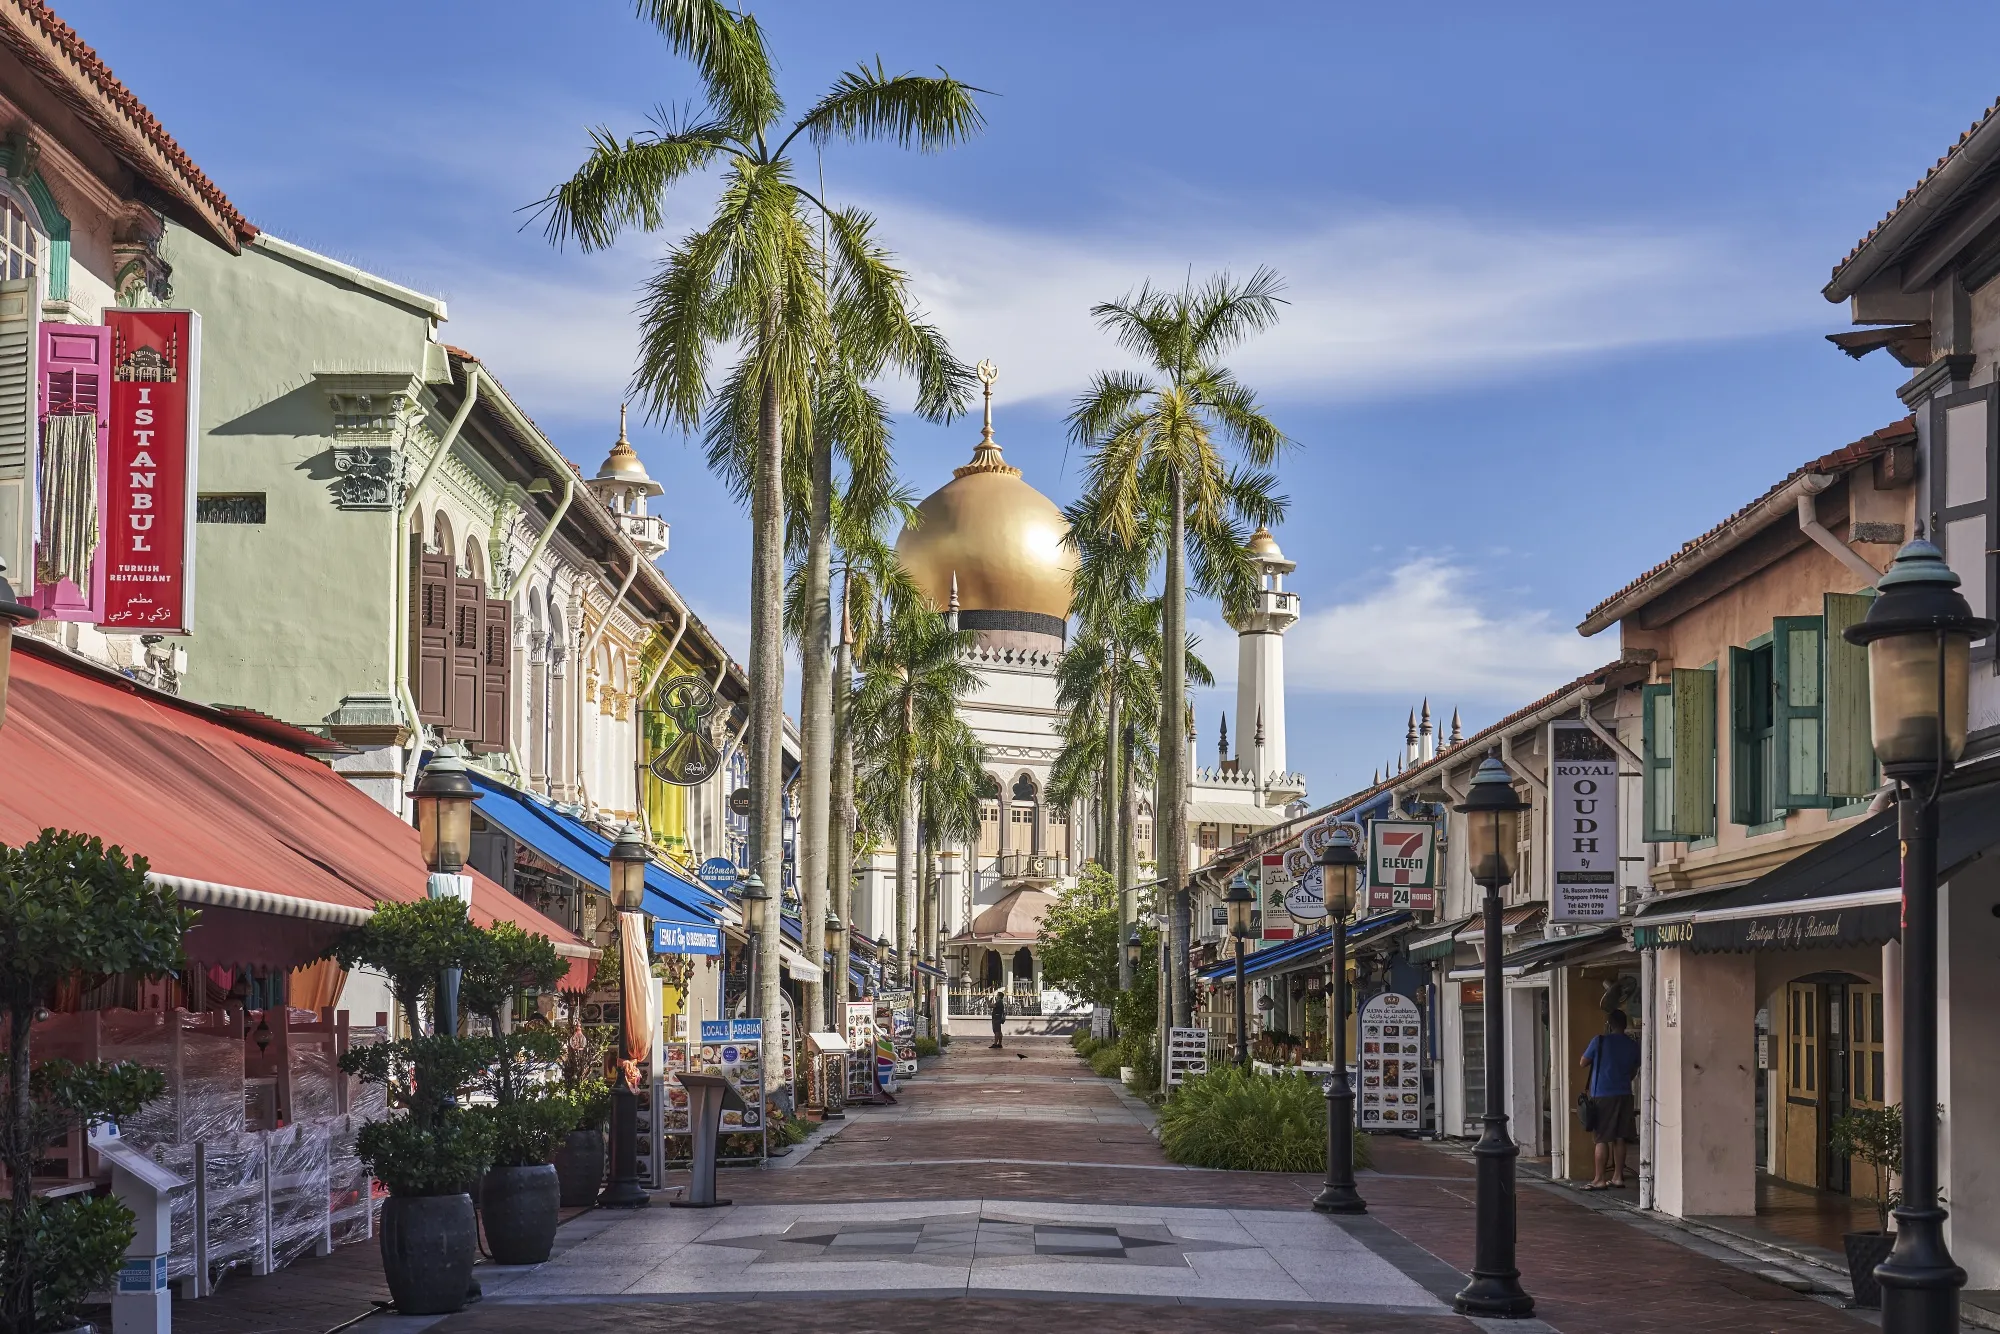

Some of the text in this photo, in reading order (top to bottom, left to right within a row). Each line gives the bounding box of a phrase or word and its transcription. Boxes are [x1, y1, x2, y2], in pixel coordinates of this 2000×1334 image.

[129, 388, 157, 551] ISTANBUL
[118, 564, 160, 573] TURKISH
[109, 574, 171, 582] RESTAURANT
[127, 592, 153, 608] مطعم
[108, 607, 171, 623] تركي و عربي
[1556, 766, 1614, 776] ROYAL
[1572, 779, 1599, 853] OUDH
[701, 862, 735, 875] Ottoman
[1581, 858, 1590, 869] By
[1374, 889, 1432, 904] OPEN 24 HOURS
[1745, 920, 1775, 947] Boutique
[1793, 917, 1802, 946] by
[702, 1023, 761, 1037] LOCAL & ARABIAN
